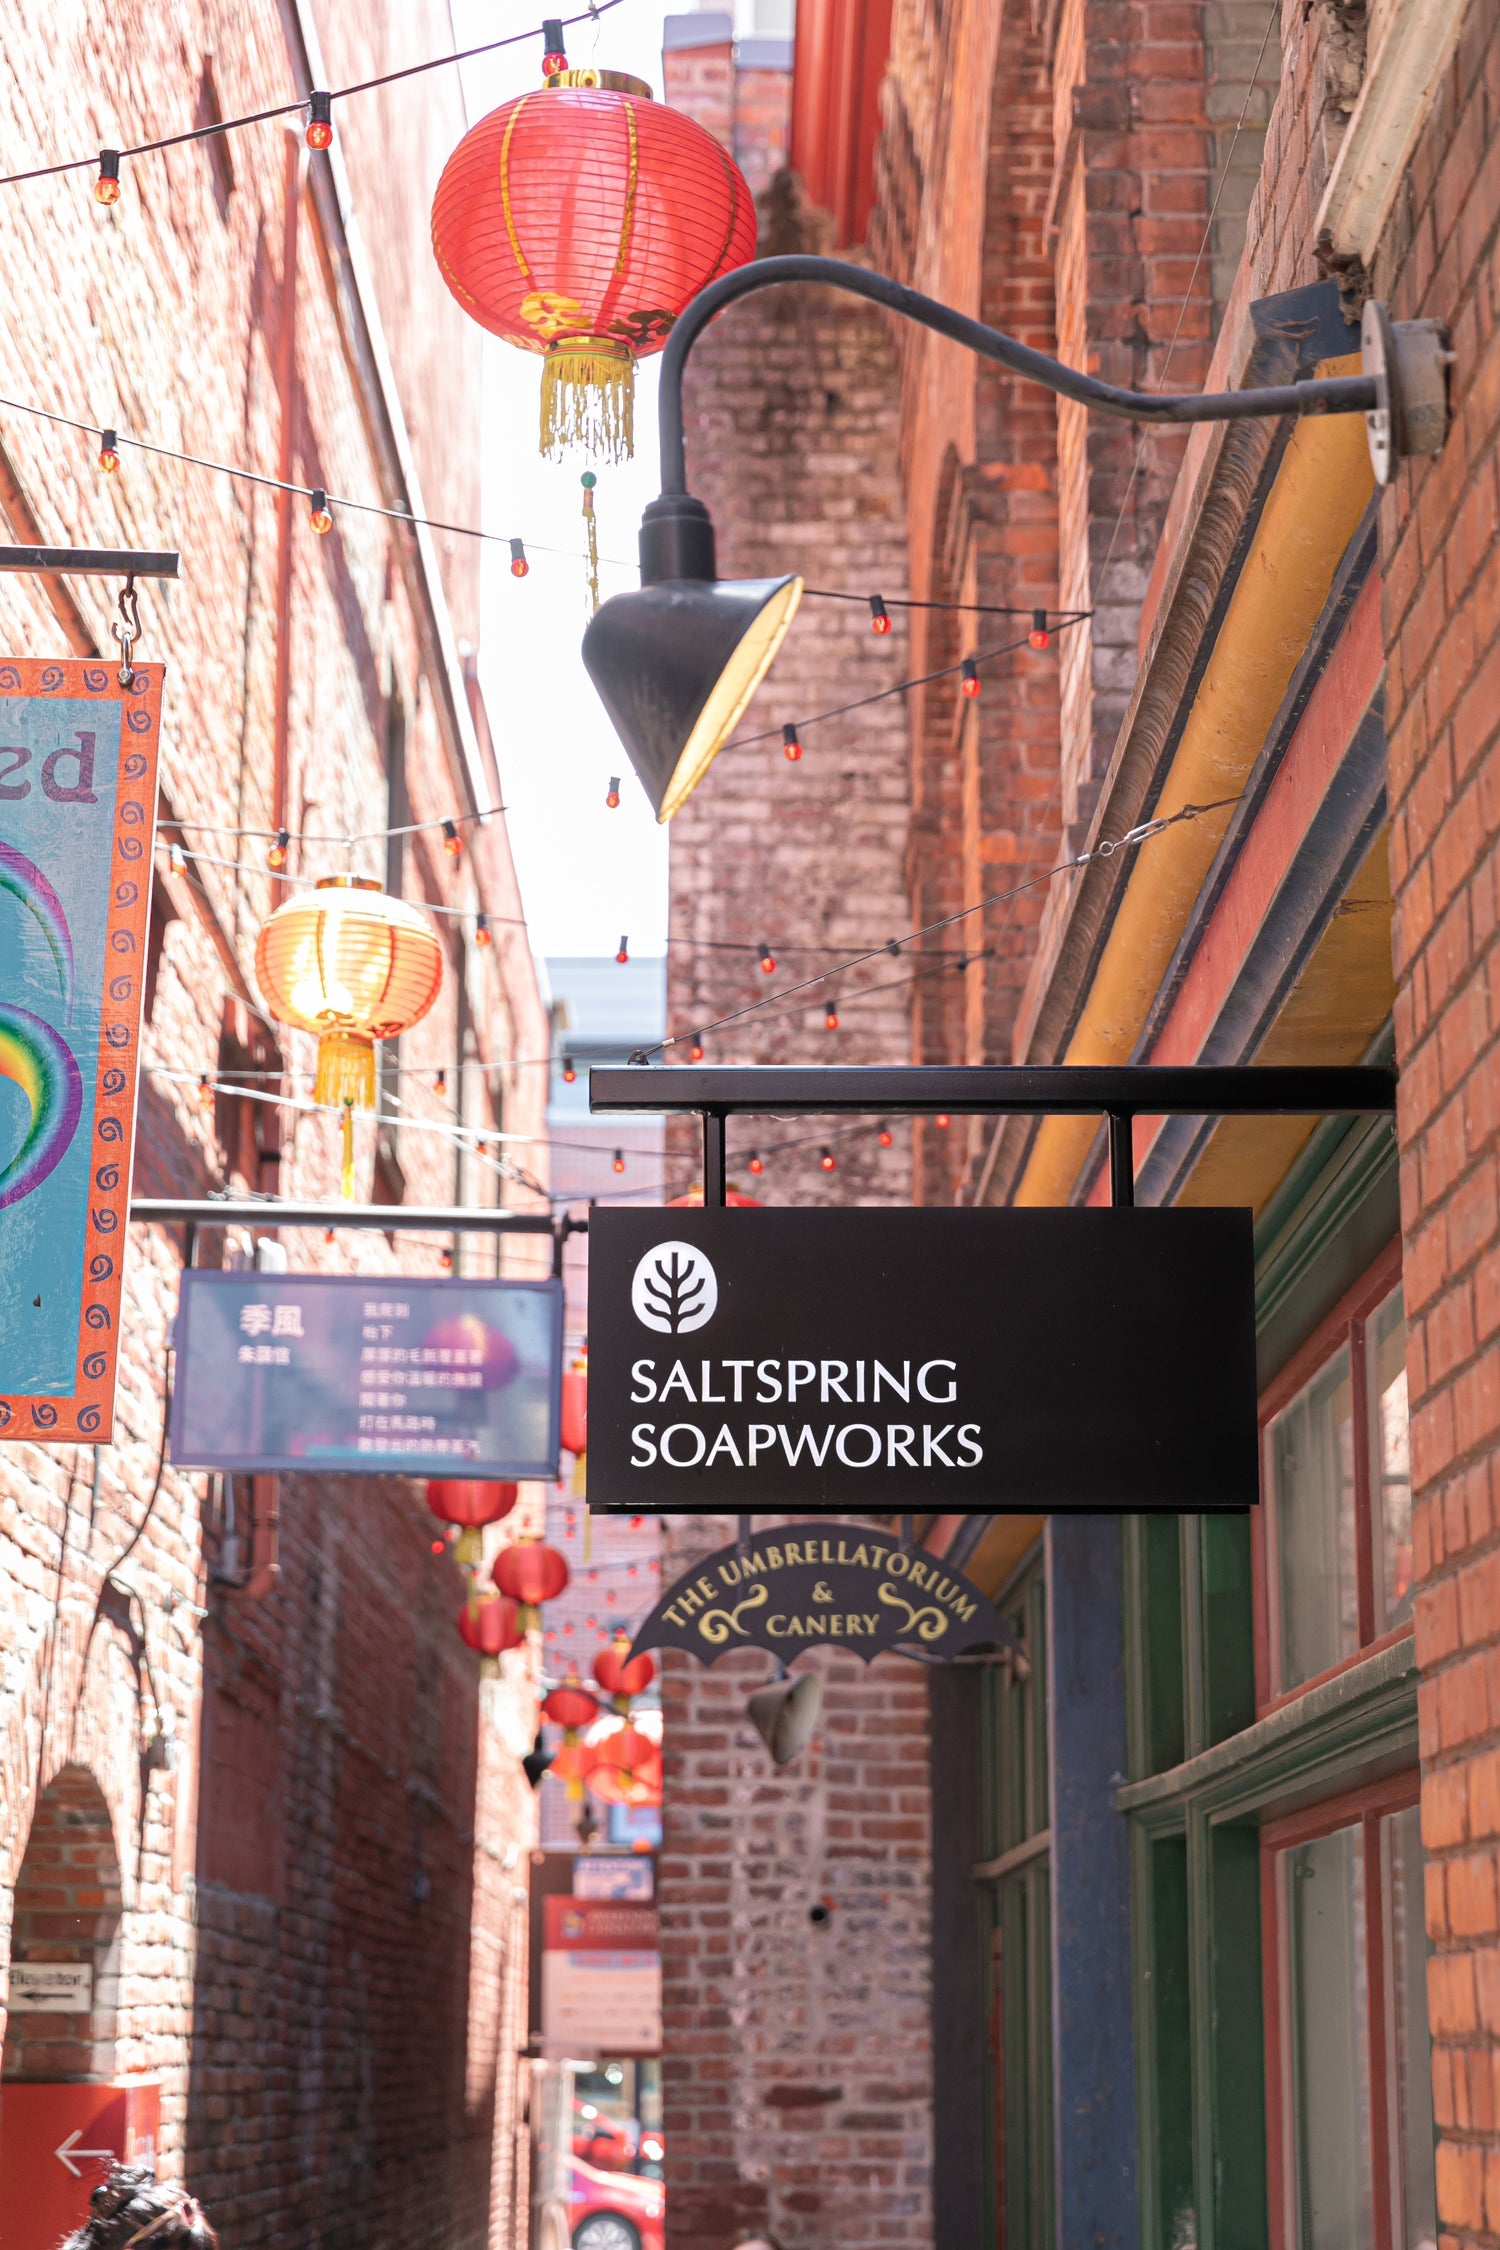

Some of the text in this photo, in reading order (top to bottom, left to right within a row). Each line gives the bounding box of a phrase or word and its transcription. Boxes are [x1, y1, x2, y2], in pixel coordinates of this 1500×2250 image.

[630, 1359, 958, 1403] SALTSPRING
[630, 1423, 984, 1468] SOAPWORKS
[661, 1540, 978, 1628] THE UMBRELLATORIUM
[811, 1581, 835, 1603] &
[766, 1614, 881, 1638] CANERY
[9, 1970, 81, 1986] Eleator
